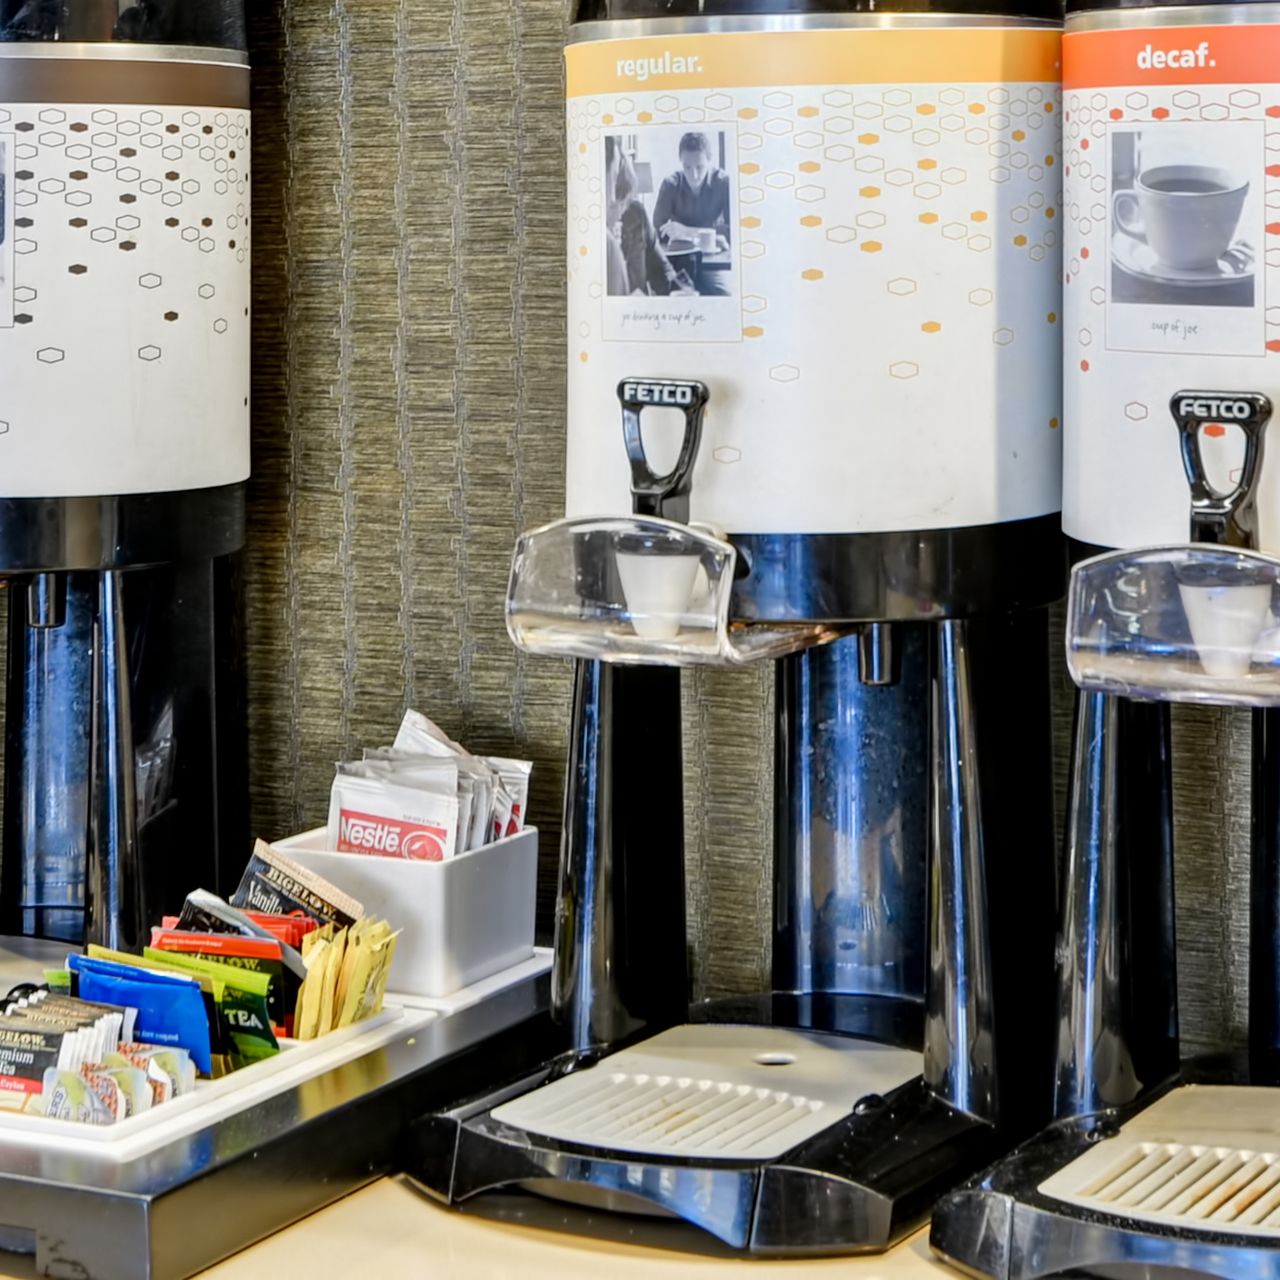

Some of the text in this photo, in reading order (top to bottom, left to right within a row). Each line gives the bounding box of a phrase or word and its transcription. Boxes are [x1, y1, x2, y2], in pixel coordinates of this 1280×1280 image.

[616, 49, 704, 81] regular.
[1136, 41, 1217, 70] decaf.
[1151, 321, 1170, 336] cup
[623, 382, 692, 404] FETCO
[1179, 398, 1252, 420] FETCO
[340, 815, 401, 853] Nestlé
[247, 880, 284, 915] Vanilla
[224, 1008, 264, 1030] TEA
